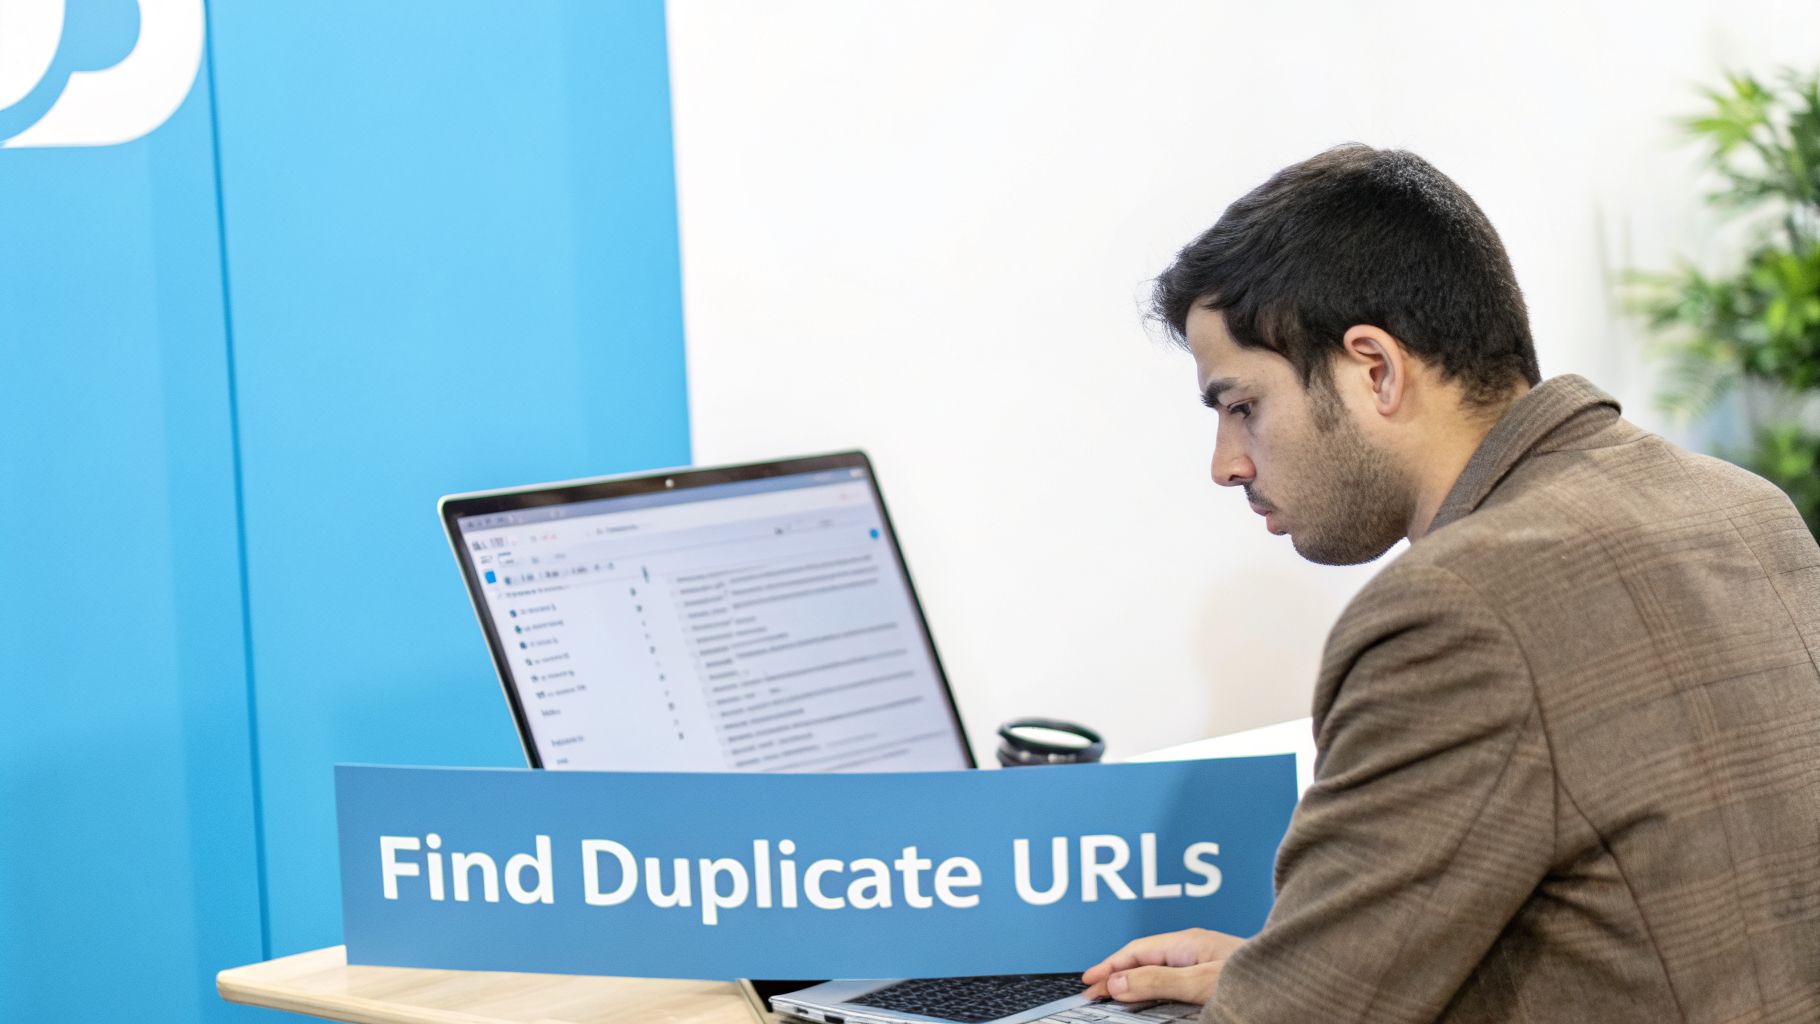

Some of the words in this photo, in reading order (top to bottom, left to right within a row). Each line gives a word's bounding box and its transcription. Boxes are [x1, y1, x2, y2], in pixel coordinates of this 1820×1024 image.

[379, 833, 555, 905] Find
[581, 839, 982, 926] Duplicate
[1013, 832, 1221, 906] URLs
